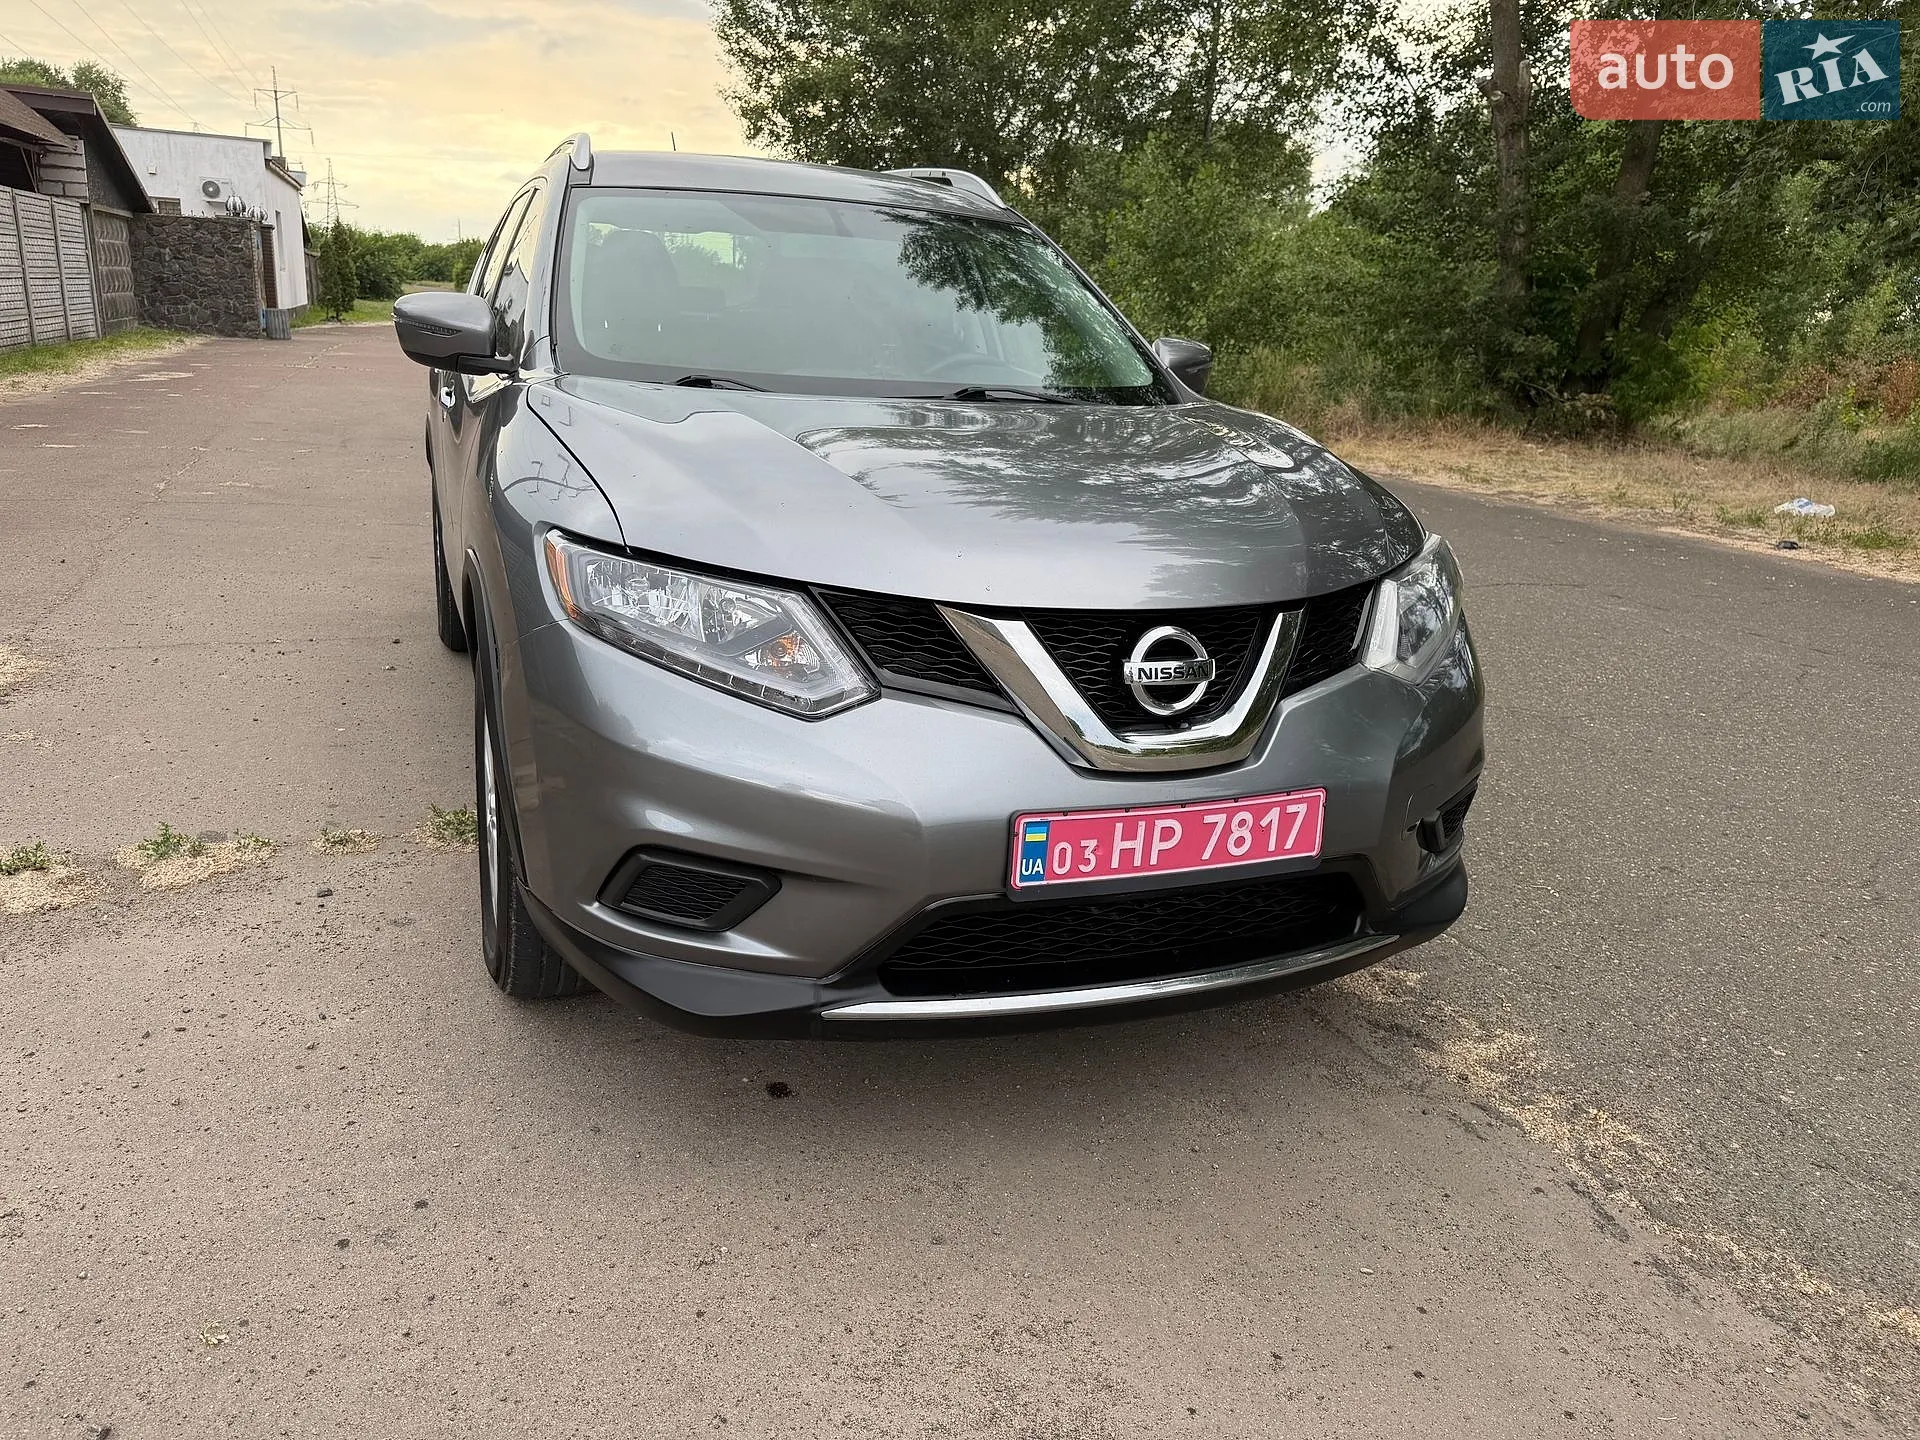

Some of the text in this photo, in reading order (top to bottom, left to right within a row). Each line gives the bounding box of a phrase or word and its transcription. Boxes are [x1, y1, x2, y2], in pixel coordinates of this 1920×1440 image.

[1137, 665, 1209, 680] NISSAN
[1051, 803, 1308, 875] 03 HP 7817
[1021, 857, 1044, 876] UA
